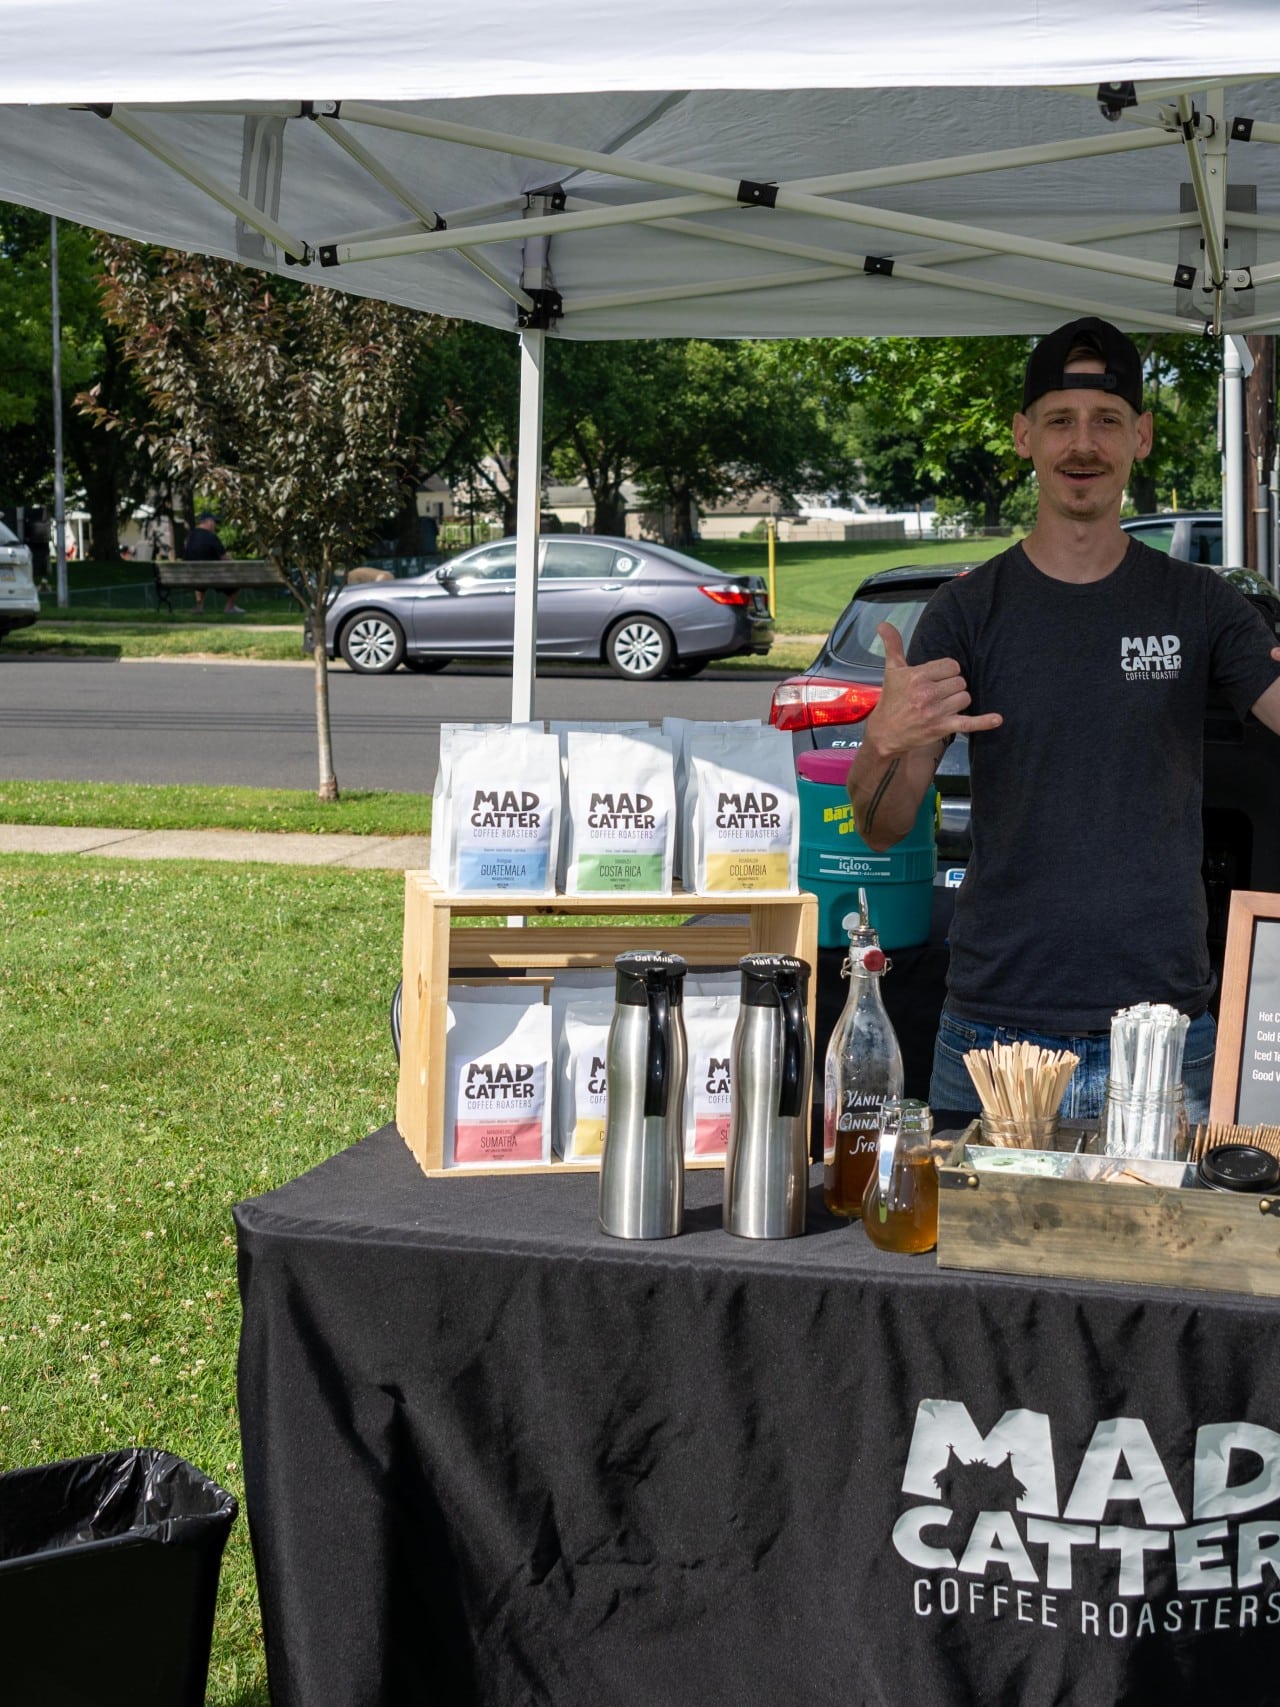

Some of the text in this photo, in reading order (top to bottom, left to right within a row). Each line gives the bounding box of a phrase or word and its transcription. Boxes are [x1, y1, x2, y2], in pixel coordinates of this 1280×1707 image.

[1121, 635, 1180, 657] MAD
[1121, 655, 1182, 671] CATTER
[1125, 672, 1150, 680] COFFEE
[473, 790, 540, 812] MAD
[589, 793, 653, 813] MAD
[717, 792, 778, 813] MAD
[470, 812, 541, 828] CATTER
[587, 814, 656, 829] CATTER
[716, 813, 781, 828] CATTER
[473, 828, 538, 838] COFFEE ROASTERS
[590, 830, 653, 839] COFFEE ROASTERS
[718, 829, 779, 838] COFFEE ROASTERS
[481, 865, 526, 876] GUATEMALA
[600, 866, 642, 877] COSTA RICA
[730, 865, 767, 876] COLOMBIA
[653, 955, 674, 964] Milk
[752, 958, 770, 966] Half
[782, 959, 800, 968] Half
[1258, 1011, 1273, 1022] Hot
[1256, 1030, 1276, 1042] Cold
[1254, 1049, 1273, 1062] Iced
[467, 1063, 534, 1083] MAD
[1252, 1069, 1274, 1082] Good
[465, 1083, 534, 1099] CATTER
[467, 1099, 532, 1110] COFFEE ROASTERS
[480, 1136, 517, 1148] SUMATRA
[849, 1135, 880, 1155] SYR
[913, 1578, 1058, 1628] COFFEE
